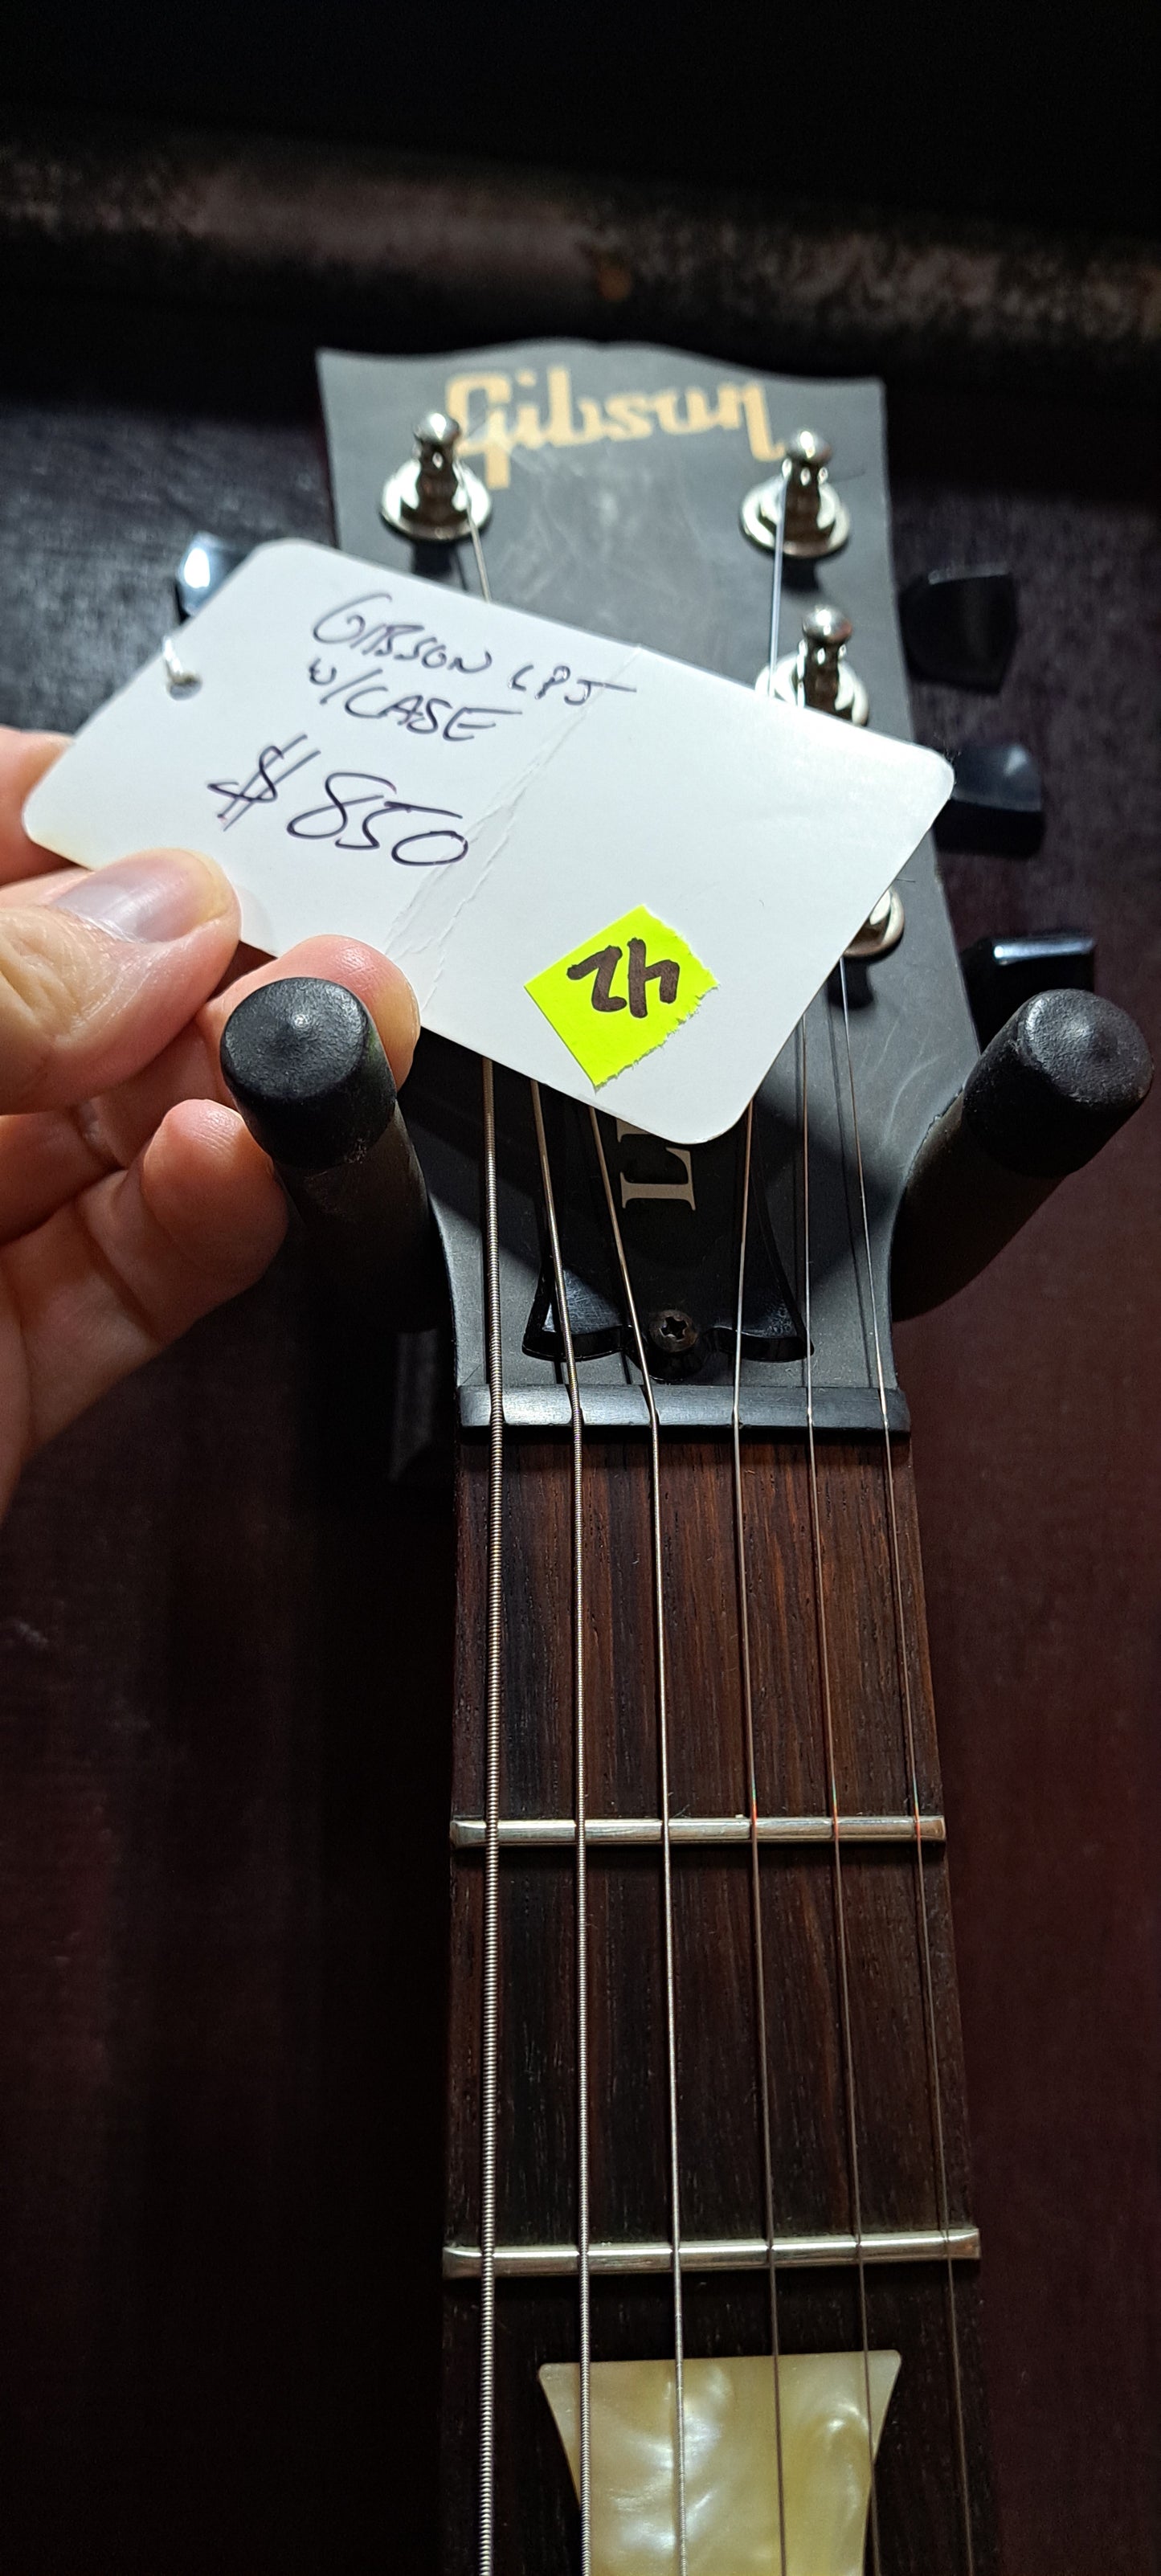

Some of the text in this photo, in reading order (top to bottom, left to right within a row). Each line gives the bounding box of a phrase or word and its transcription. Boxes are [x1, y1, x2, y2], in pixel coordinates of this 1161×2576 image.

[446, 366, 787, 489] Gibson
[313, 592, 493, 674] GIBSON
[206, 733, 469, 866] $850
